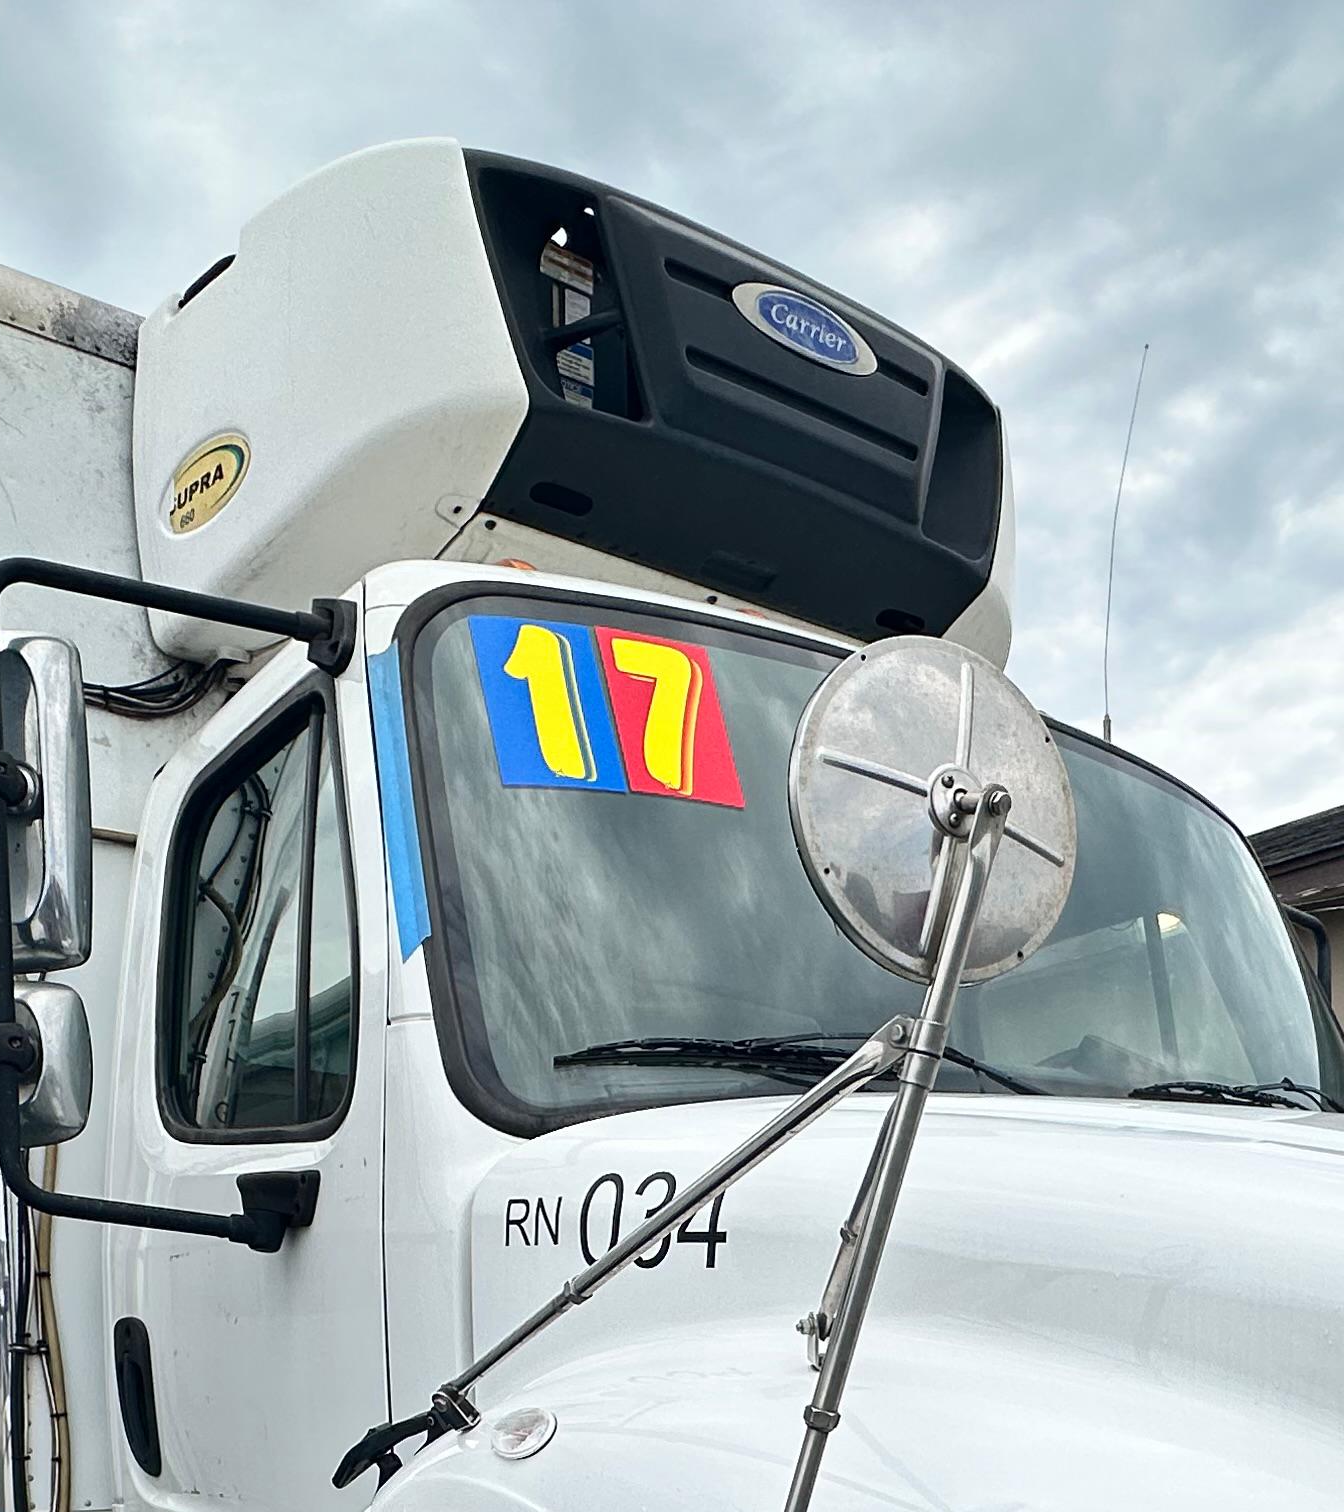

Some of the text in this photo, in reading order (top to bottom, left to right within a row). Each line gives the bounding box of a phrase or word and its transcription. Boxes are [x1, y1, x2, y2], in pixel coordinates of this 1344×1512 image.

[770, 303, 848, 352] Carrier
[505, 1171, 727, 1269] RN 034
